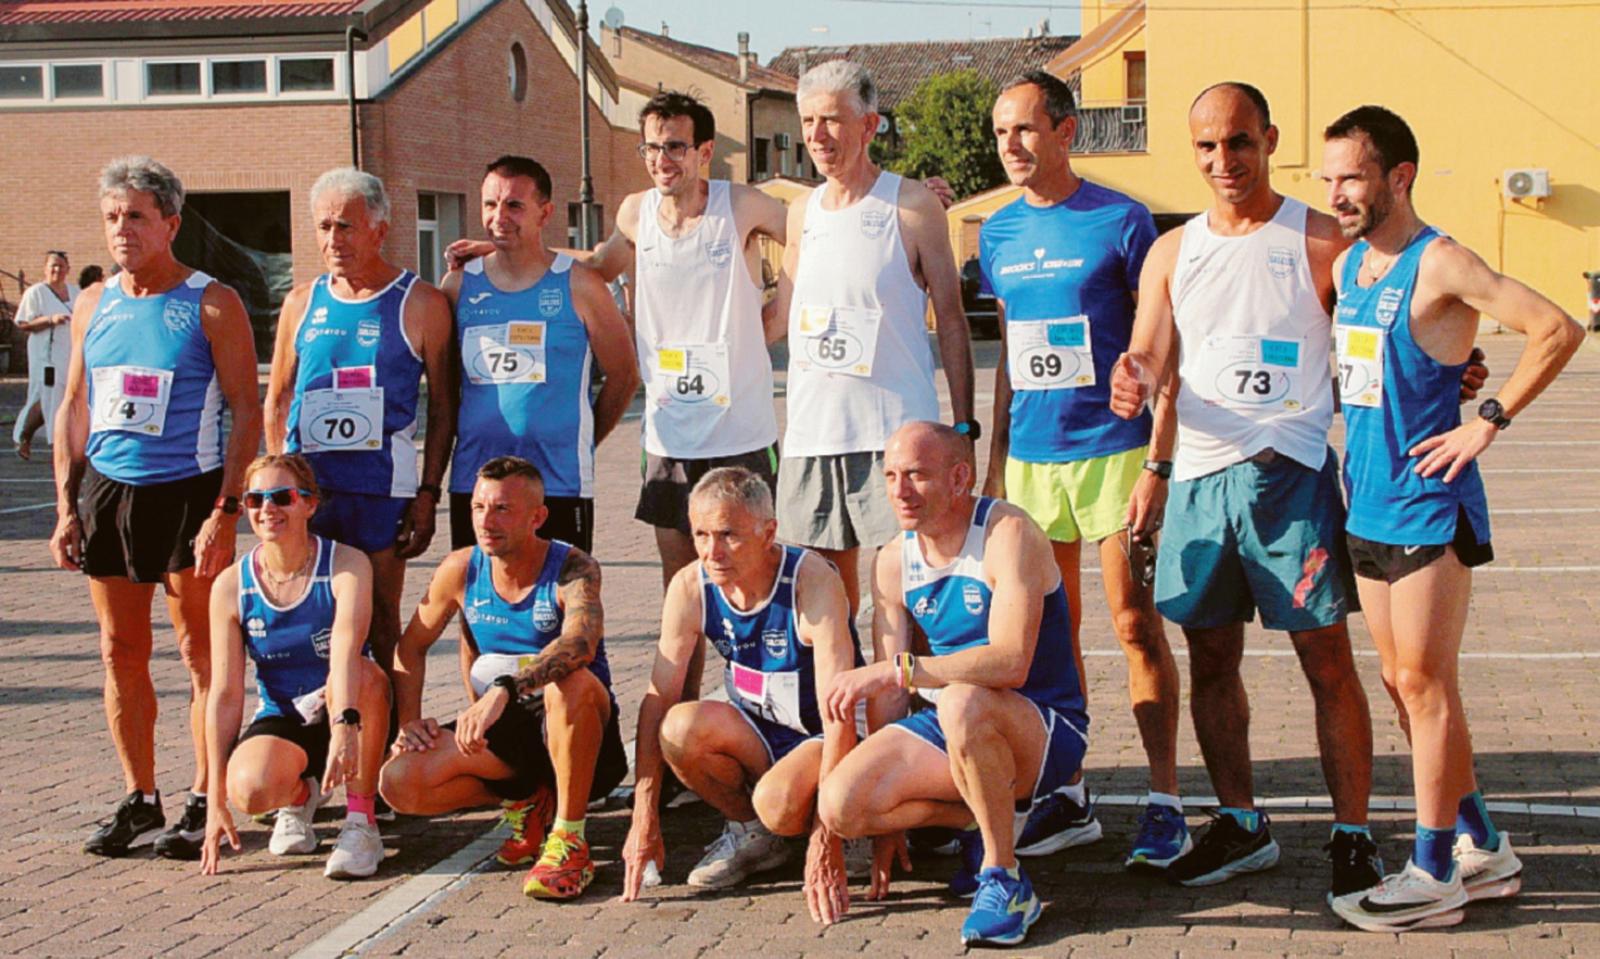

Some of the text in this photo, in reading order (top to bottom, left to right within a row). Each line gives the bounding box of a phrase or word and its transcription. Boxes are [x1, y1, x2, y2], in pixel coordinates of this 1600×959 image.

[819, 338, 847, 361] 65
[488, 352, 518, 373] 75
[1030, 353, 1062, 378] 69
[676, 374, 704, 395] 64
[1235, 370, 1272, 395] 73
[109, 397, 136, 419] 74
[324, 418, 356, 439] 70
